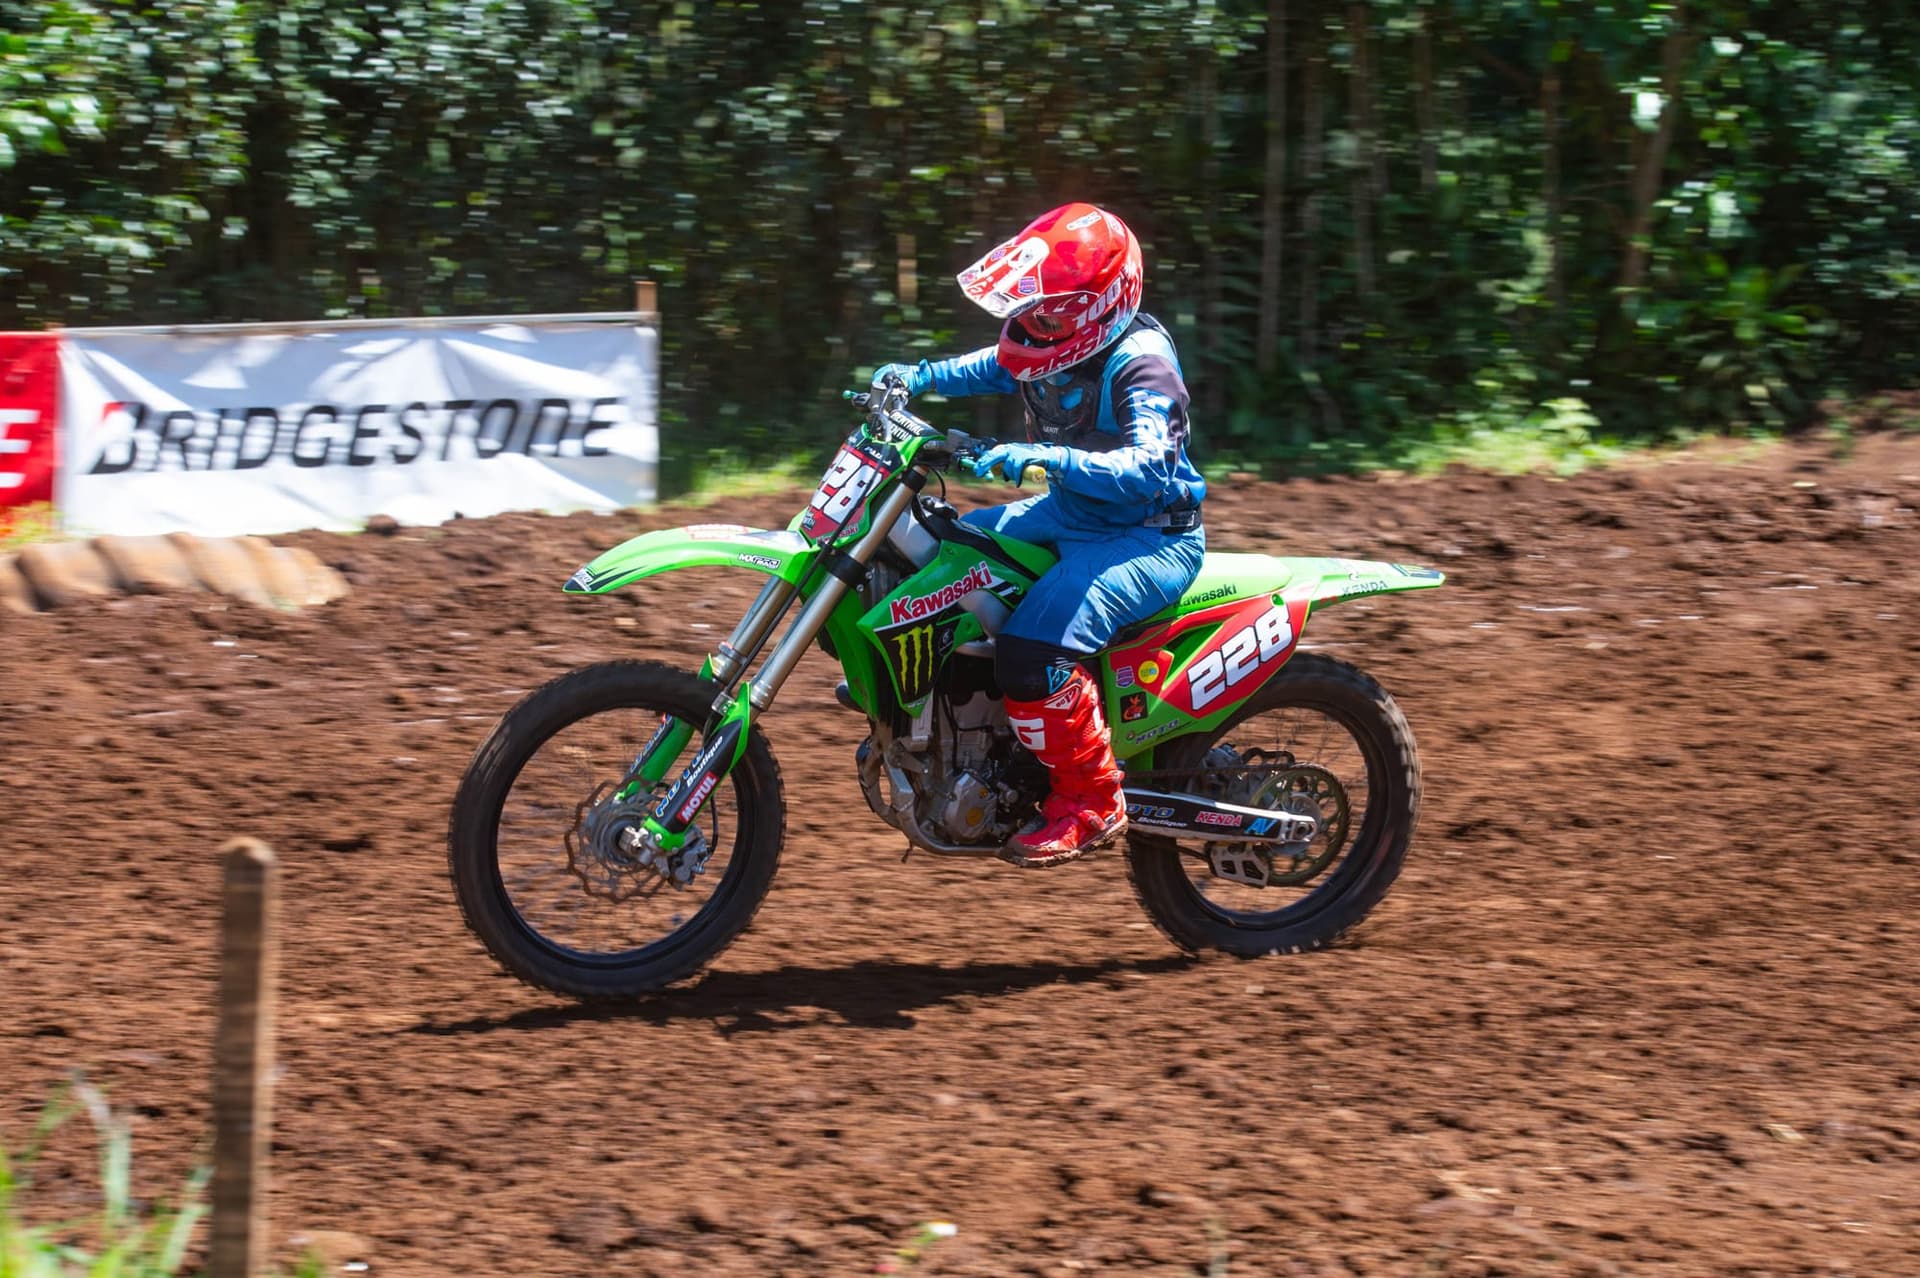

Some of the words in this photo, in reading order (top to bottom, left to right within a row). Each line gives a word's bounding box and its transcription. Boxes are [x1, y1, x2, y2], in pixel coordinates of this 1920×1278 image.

[89, 397, 621, 474] BRIDGESTONE
[890, 561, 992, 623] Kawasaki
[1342, 580, 1388, 596] KENDA
[1187, 606, 1293, 711] 228
[687, 735, 723, 787] Boutique
[681, 776, 717, 823] MOTUL
[1126, 803, 1175, 818] OTO
[1137, 816, 1188, 828] Boutique
[1195, 811, 1243, 827] KENDA
[1245, 818, 1277, 836] AV
